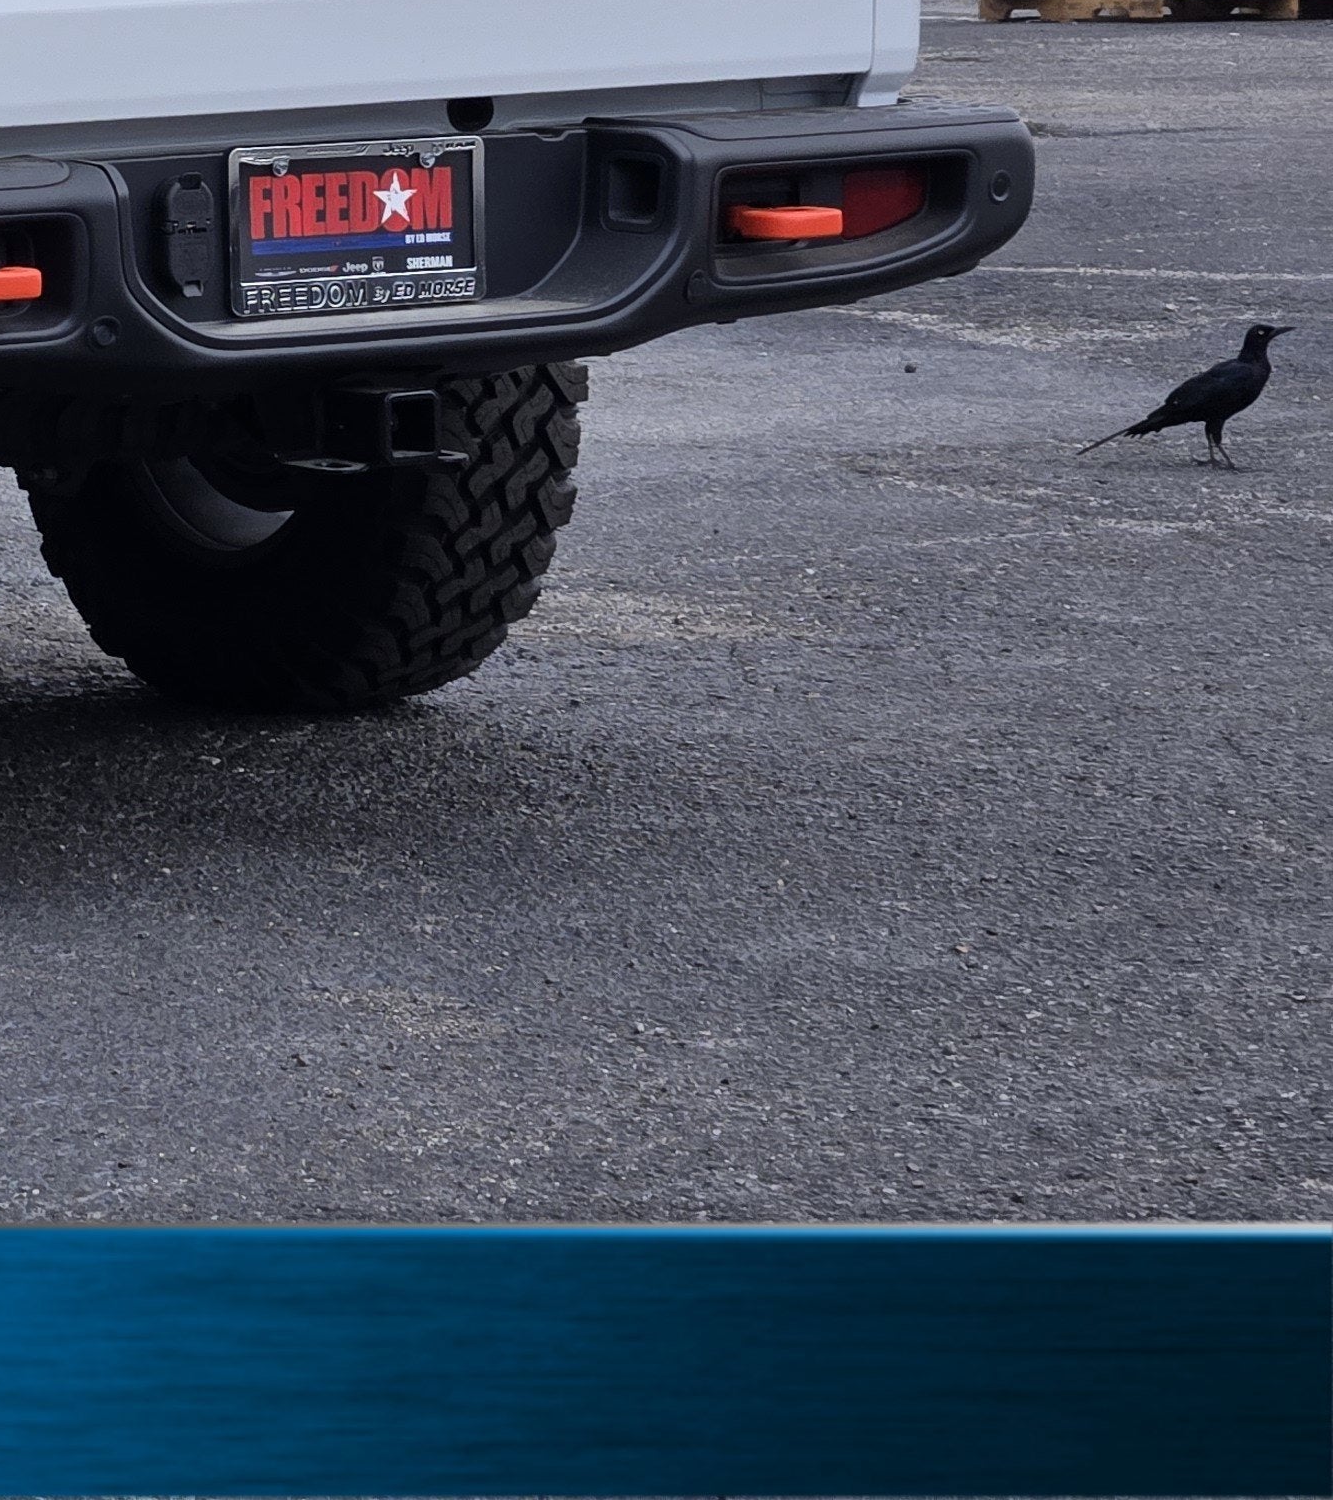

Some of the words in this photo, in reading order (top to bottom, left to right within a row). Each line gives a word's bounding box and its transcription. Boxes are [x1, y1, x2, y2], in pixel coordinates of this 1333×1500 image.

[249, 166, 452, 239] FREEDOM
[342, 262, 368, 273] Jeep
[406, 255, 453, 269] SHERMAN
[242, 280, 368, 314] FREEDOM
[392, 281, 415, 300] ED
[418, 277, 475, 299] MORSE
